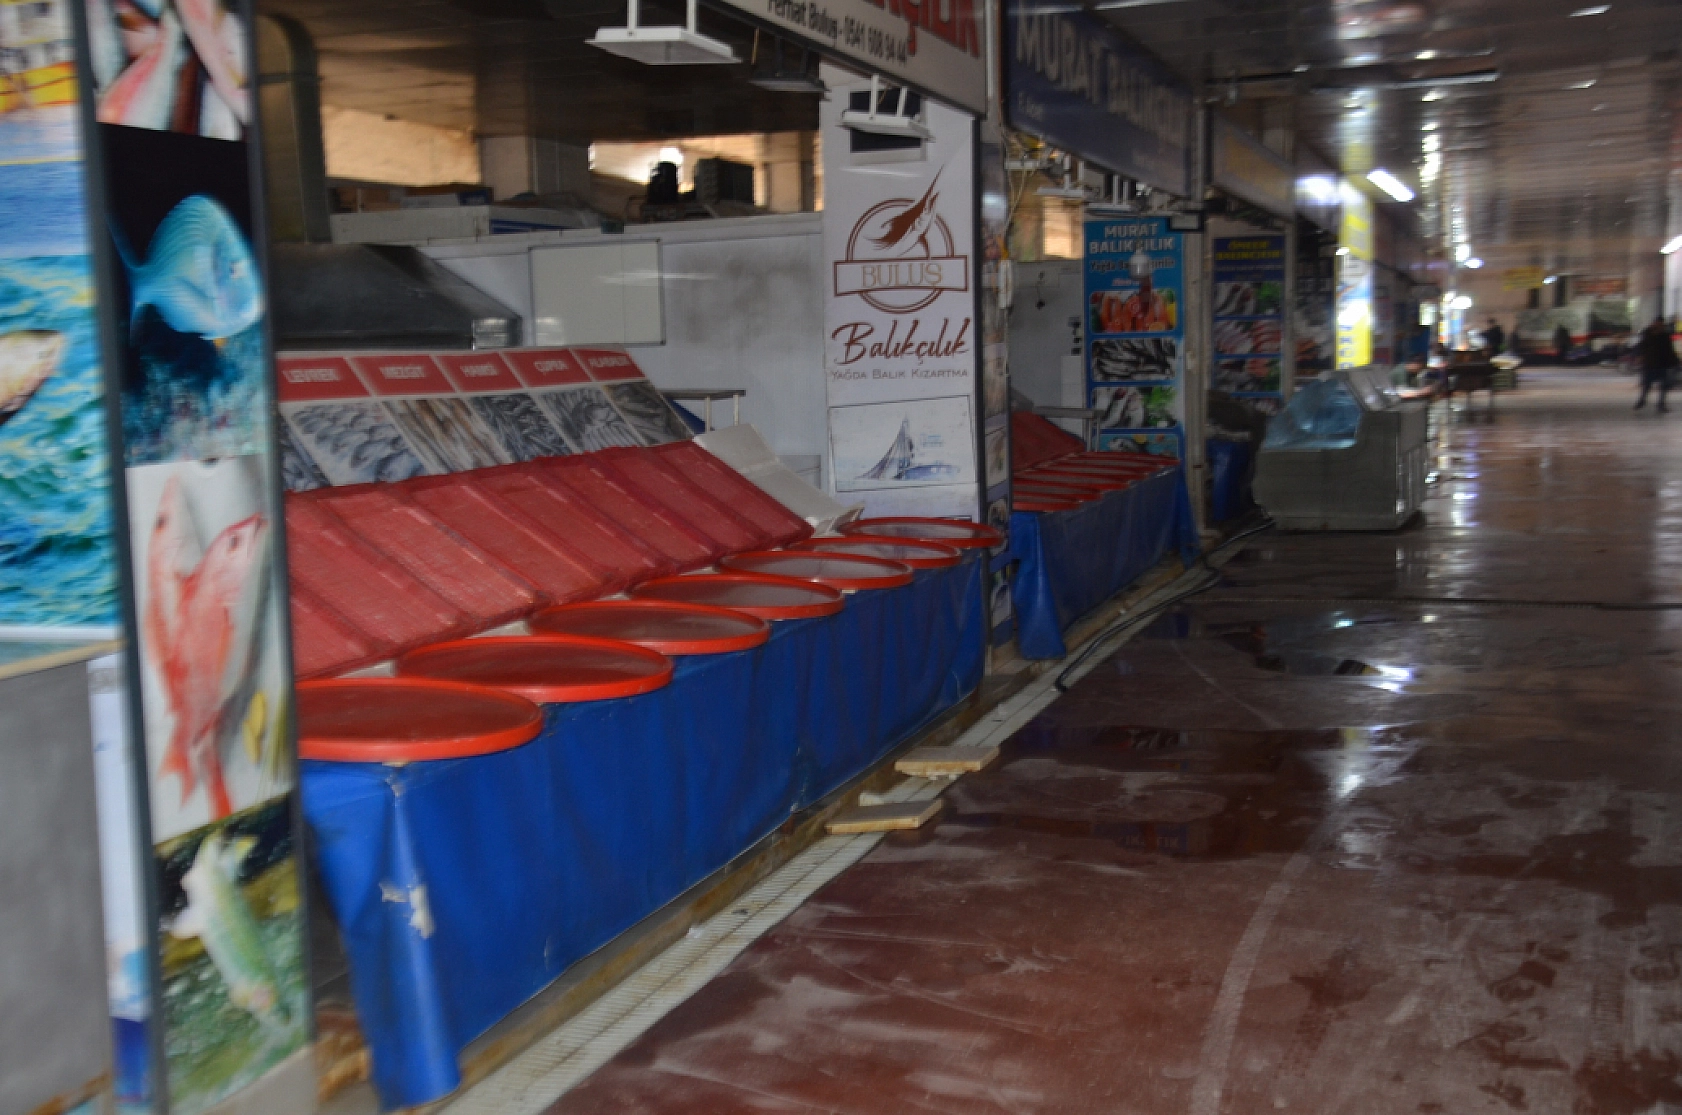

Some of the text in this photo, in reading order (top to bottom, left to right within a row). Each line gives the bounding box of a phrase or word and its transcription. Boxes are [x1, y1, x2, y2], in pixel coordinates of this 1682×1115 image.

[1104, 223, 1159, 238] MURAT
[831, 317, 971, 365] Balıkçılık
[831, 368, 968, 380] YAĞDA BALIK KIZARTMA
